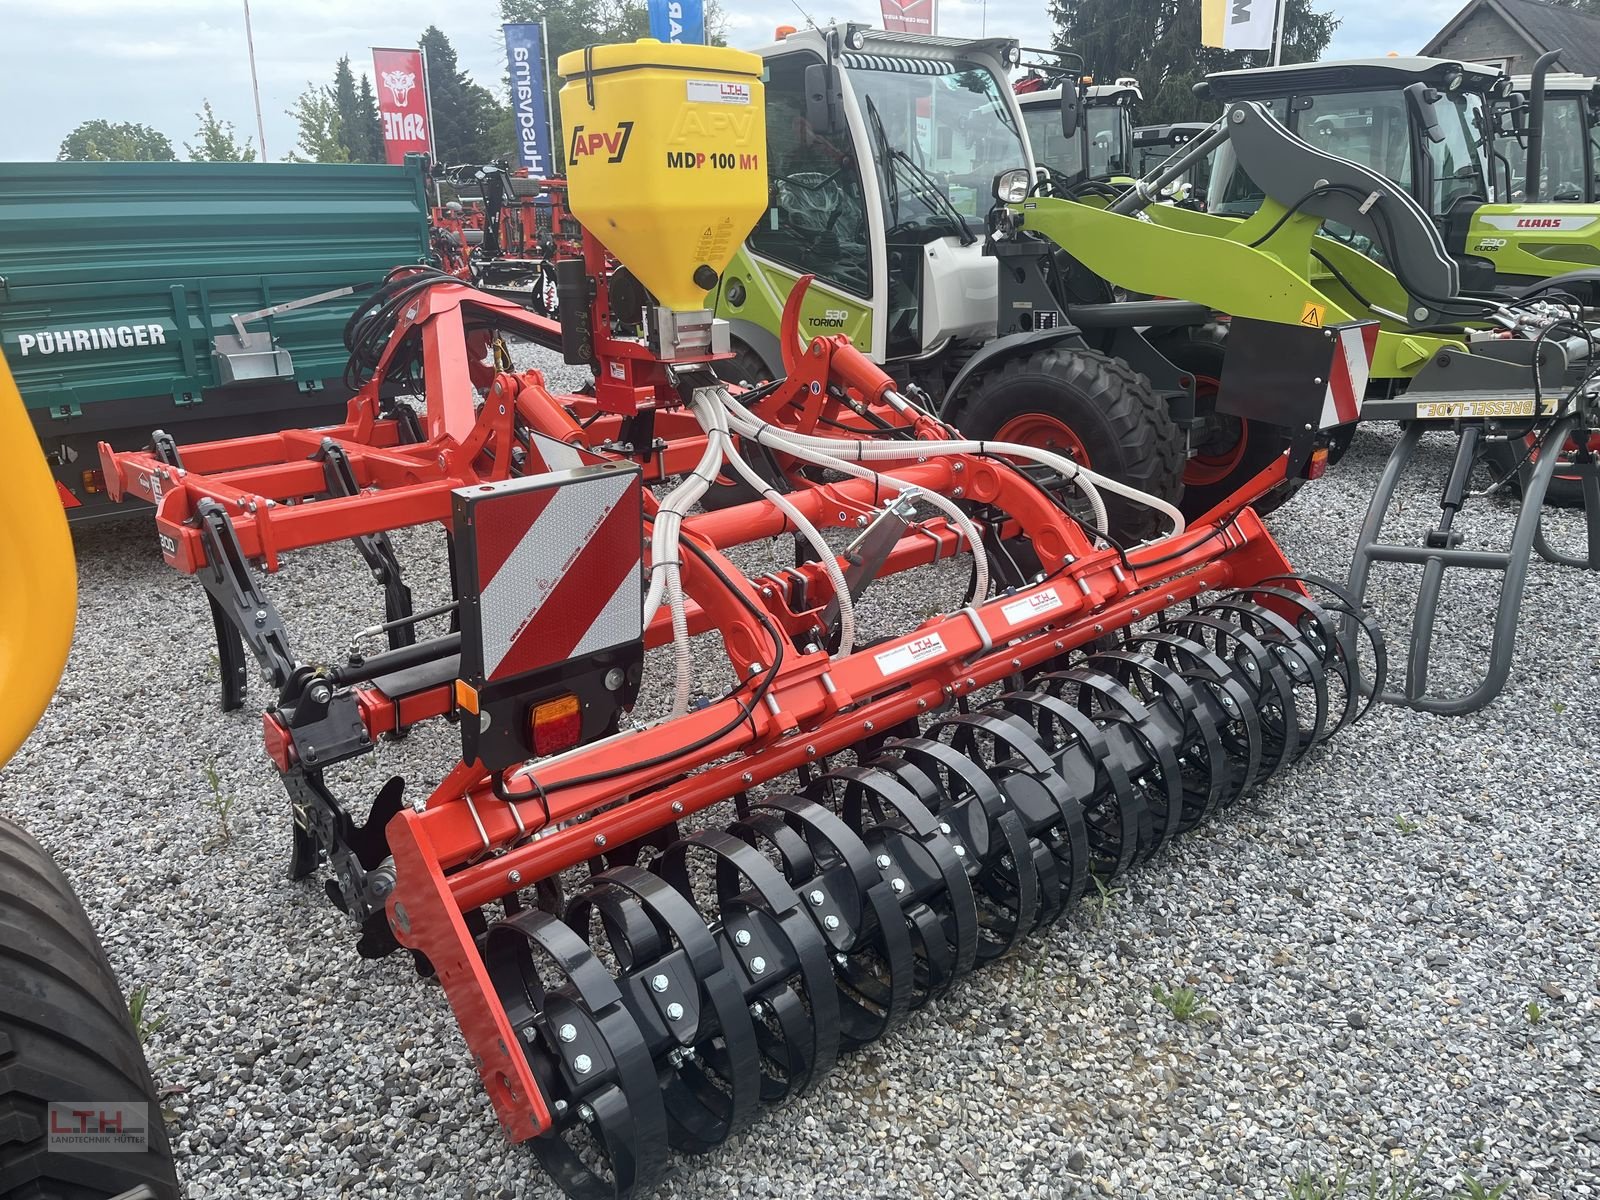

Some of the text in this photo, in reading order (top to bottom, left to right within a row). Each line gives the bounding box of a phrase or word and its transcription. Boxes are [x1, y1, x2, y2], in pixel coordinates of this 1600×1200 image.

[667, 151, 758, 170] MDP 100 M1
[1517, 219, 1561, 228] CLAAS
[1480, 238, 1507, 247] 230
[825, 310, 849, 320] 530
[808, 318, 844, 328] TORION
[18, 323, 167, 357] PÜHRINGER
